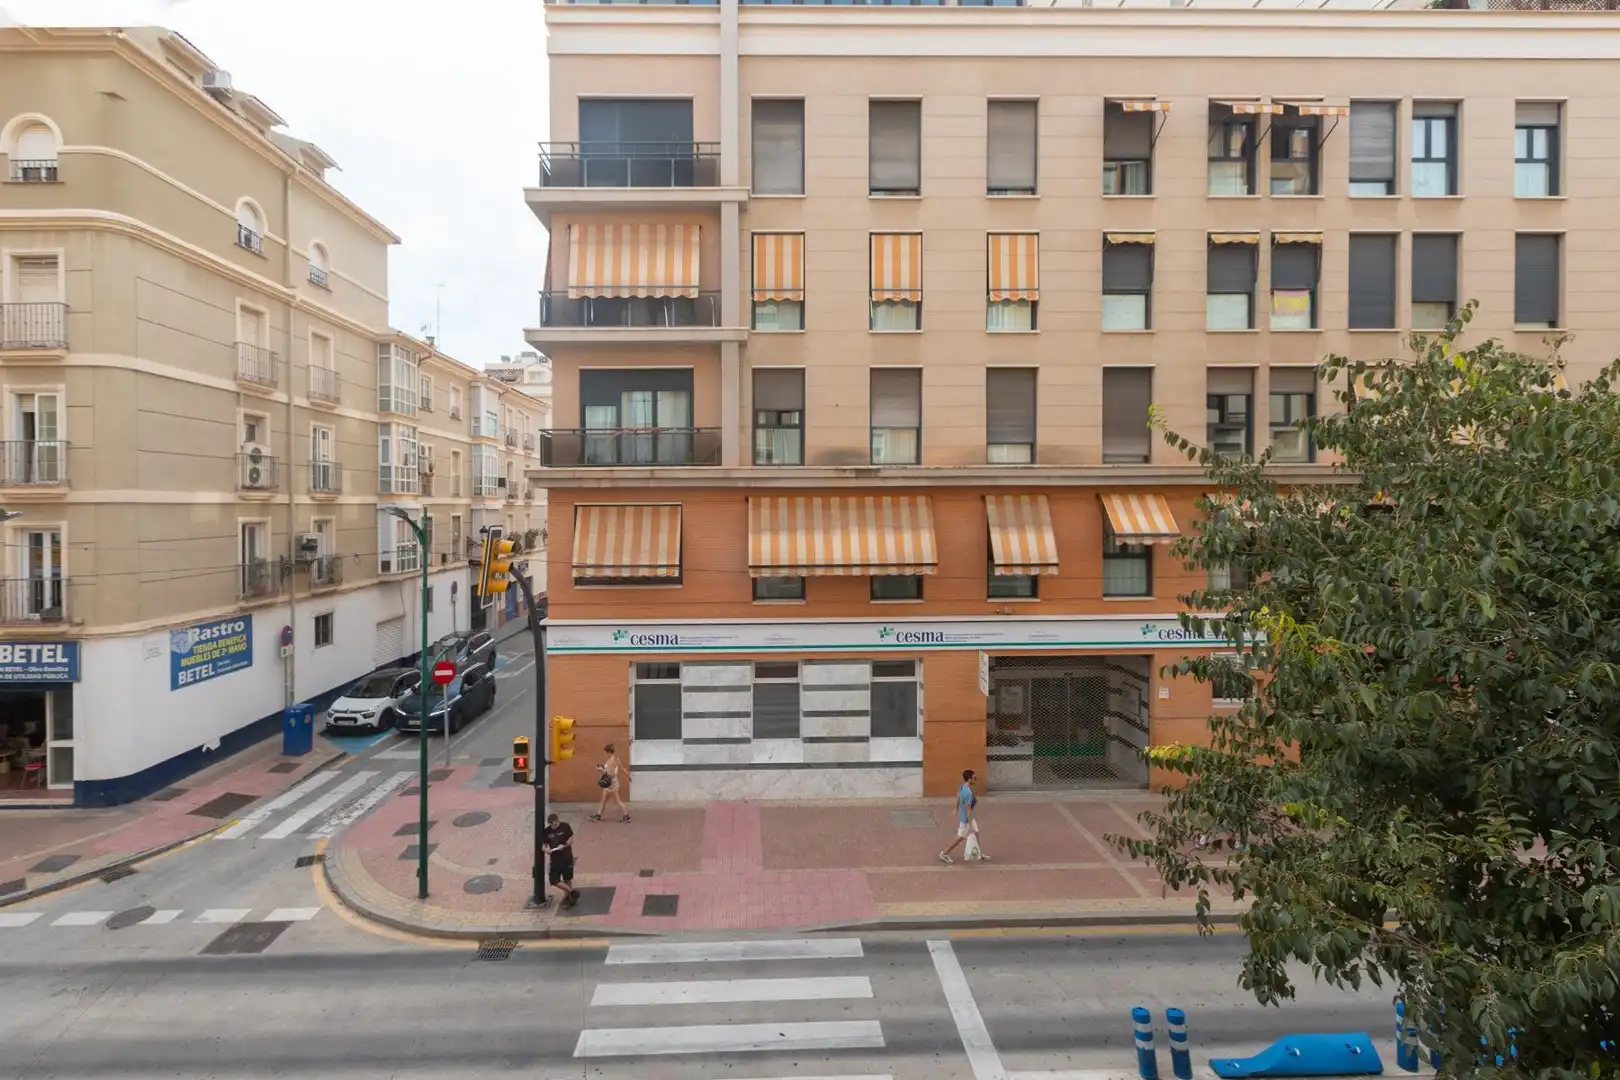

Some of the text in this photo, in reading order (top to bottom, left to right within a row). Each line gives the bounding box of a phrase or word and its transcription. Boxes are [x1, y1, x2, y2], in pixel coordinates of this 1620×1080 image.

[187, 621, 245, 641] Rastro
[630, 634, 679, 646] cesma
[896, 631, 944, 643] cesma
[0, 643, 69, 664] BETEL
[181, 652, 211, 667] MUEBLES
[212, 649, 221, 659] DE
[228, 642, 248, 655] MANO
[193, 640, 217, 655] TIENDA
[178, 663, 216, 685] BETEL
